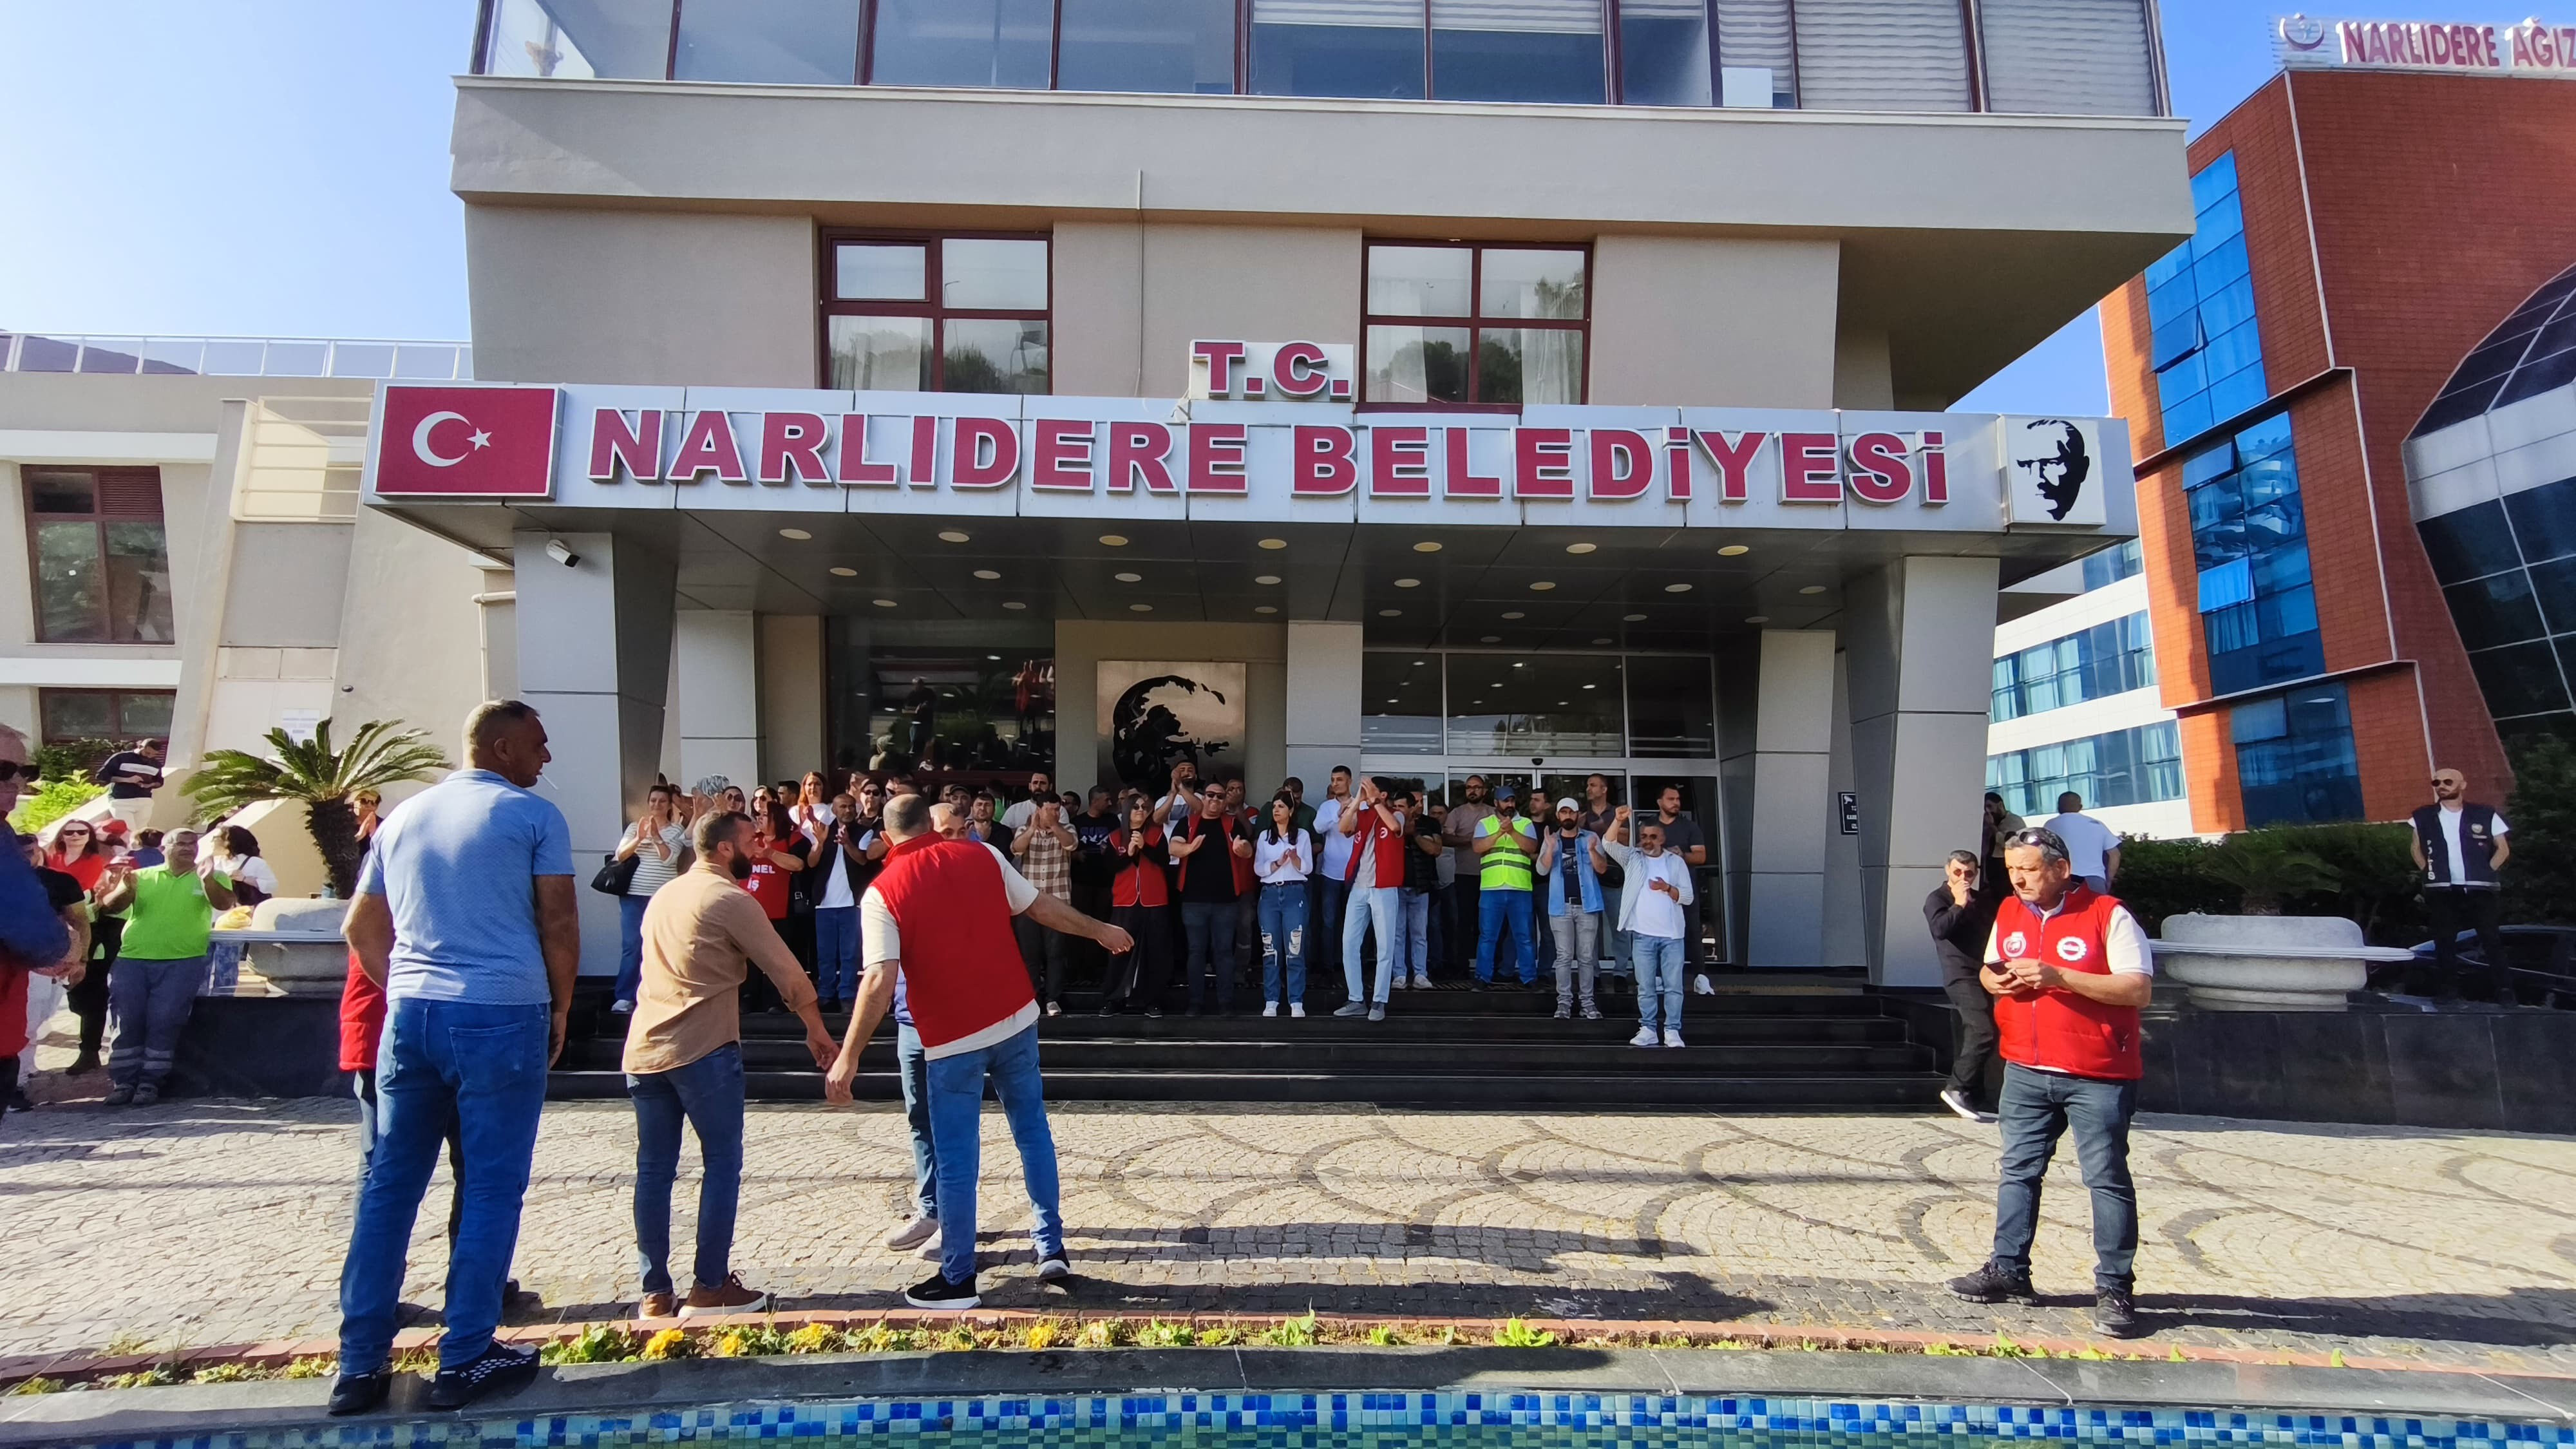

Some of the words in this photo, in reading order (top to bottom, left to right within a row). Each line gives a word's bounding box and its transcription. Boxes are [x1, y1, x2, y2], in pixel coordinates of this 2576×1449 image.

[2339, 21, 2500, 67] NARLIDERE
[2508, 16, 2576, 68] AĞIZ
[1192, 339, 1352, 397] T.C.
[587, 407, 1249, 495] NARLIDERE
[1291, 424, 1949, 506] BELEDİYESİ
[752, 864, 776, 875] NEL
